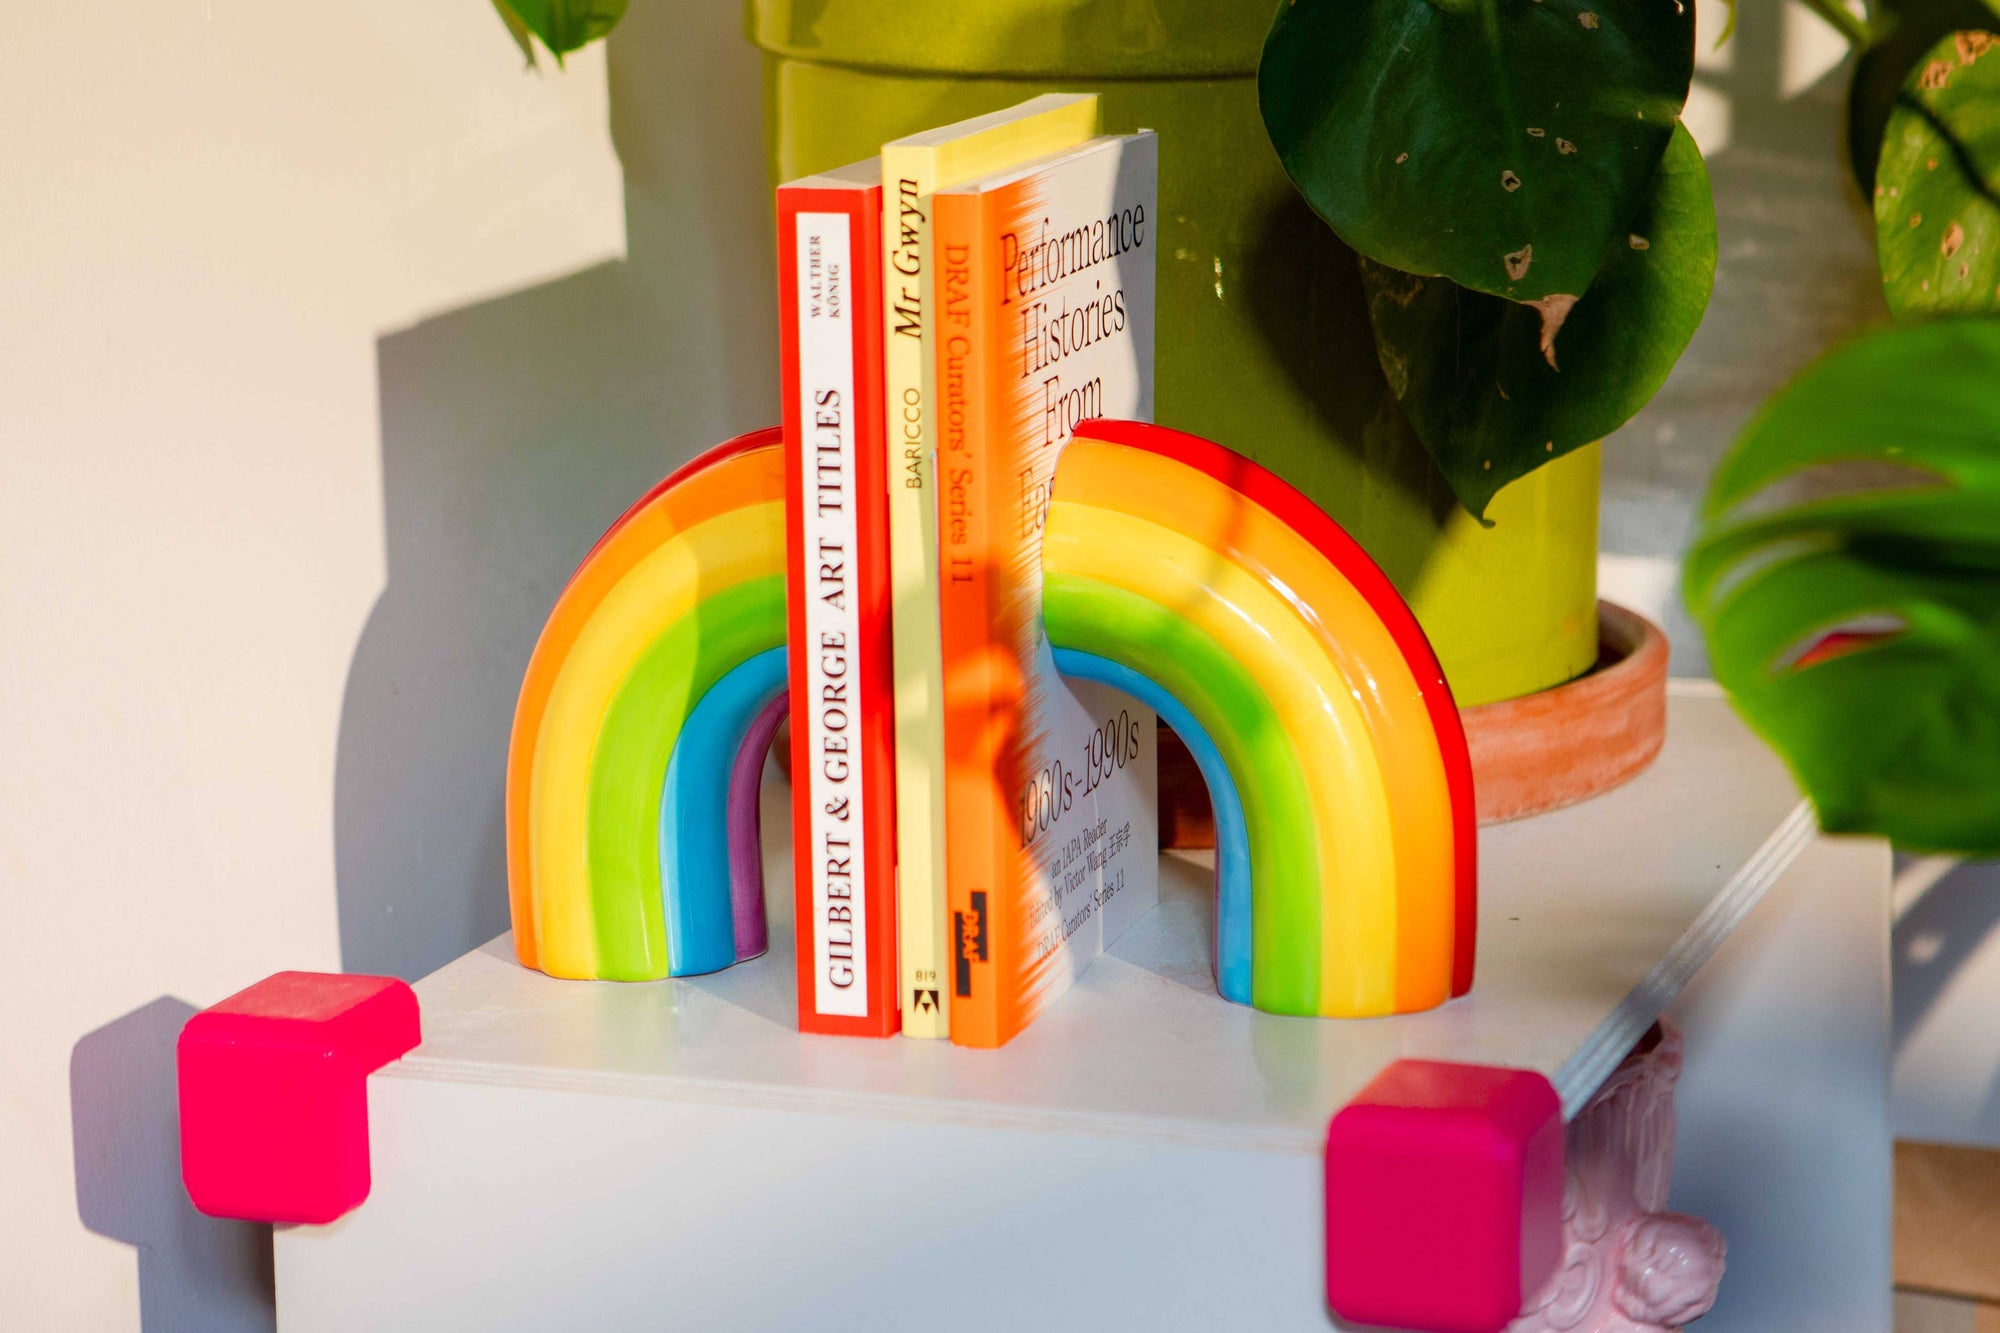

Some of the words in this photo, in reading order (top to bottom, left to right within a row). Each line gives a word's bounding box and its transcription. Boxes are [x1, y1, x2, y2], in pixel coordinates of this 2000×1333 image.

[892, 178, 926, 276] Gwyn
[1000, 203, 1145, 306] Performance
[809, 234, 823, 319] WALTHER
[828, 263, 841, 319] KÖNIG
[894, 287, 922, 343] Mr
[946, 244, 970, 328] DRAF
[1021, 280, 1126, 380] Histories
[903, 387, 923, 489] BARICCO
[1042, 375, 1104, 448] From
[815, 388, 843, 518] TITLES
[950, 468, 974, 546] Series
[818, 537, 846, 613] ART
[952, 556, 974, 585] 11
[821, 631, 851, 784] GEORGE
[825, 795, 851, 822] &
[1021, 709, 1140, 848] 1960s-1990s
[1051, 858, 1062, 880] an
[1062, 835, 1082, 869] IAPA
[1083, 818, 1108, 851] Reader
[1053, 884, 1064, 909] by
[1064, 865, 1086, 895] Victor
[1086, 847, 1108, 875] Wang
[826, 832, 855, 989] GILBERT
[1094, 882, 1115, 912] Series
